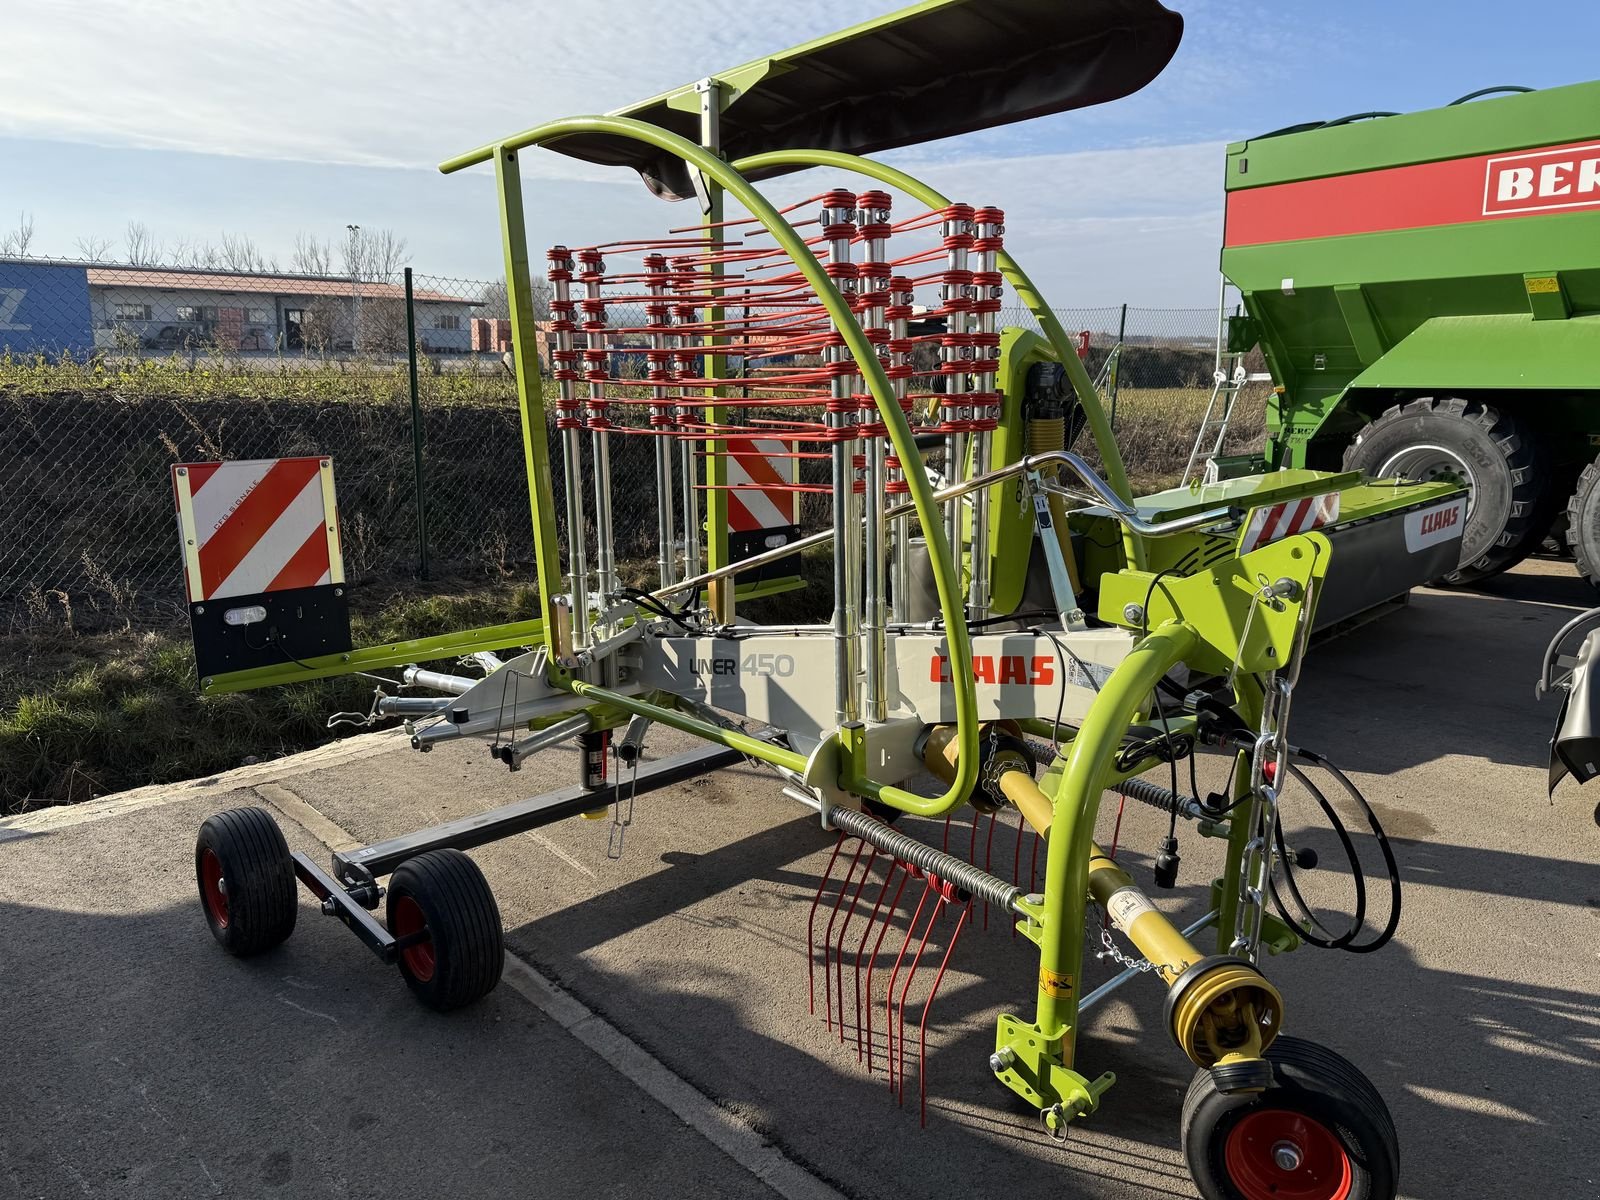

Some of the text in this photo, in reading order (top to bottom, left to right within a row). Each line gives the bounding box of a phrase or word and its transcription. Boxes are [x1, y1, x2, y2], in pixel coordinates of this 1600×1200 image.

[1420, 505, 1459, 535] CLAAS
[689, 653, 795, 678] LINER 450
[930, 655, 1054, 686] CAAS
